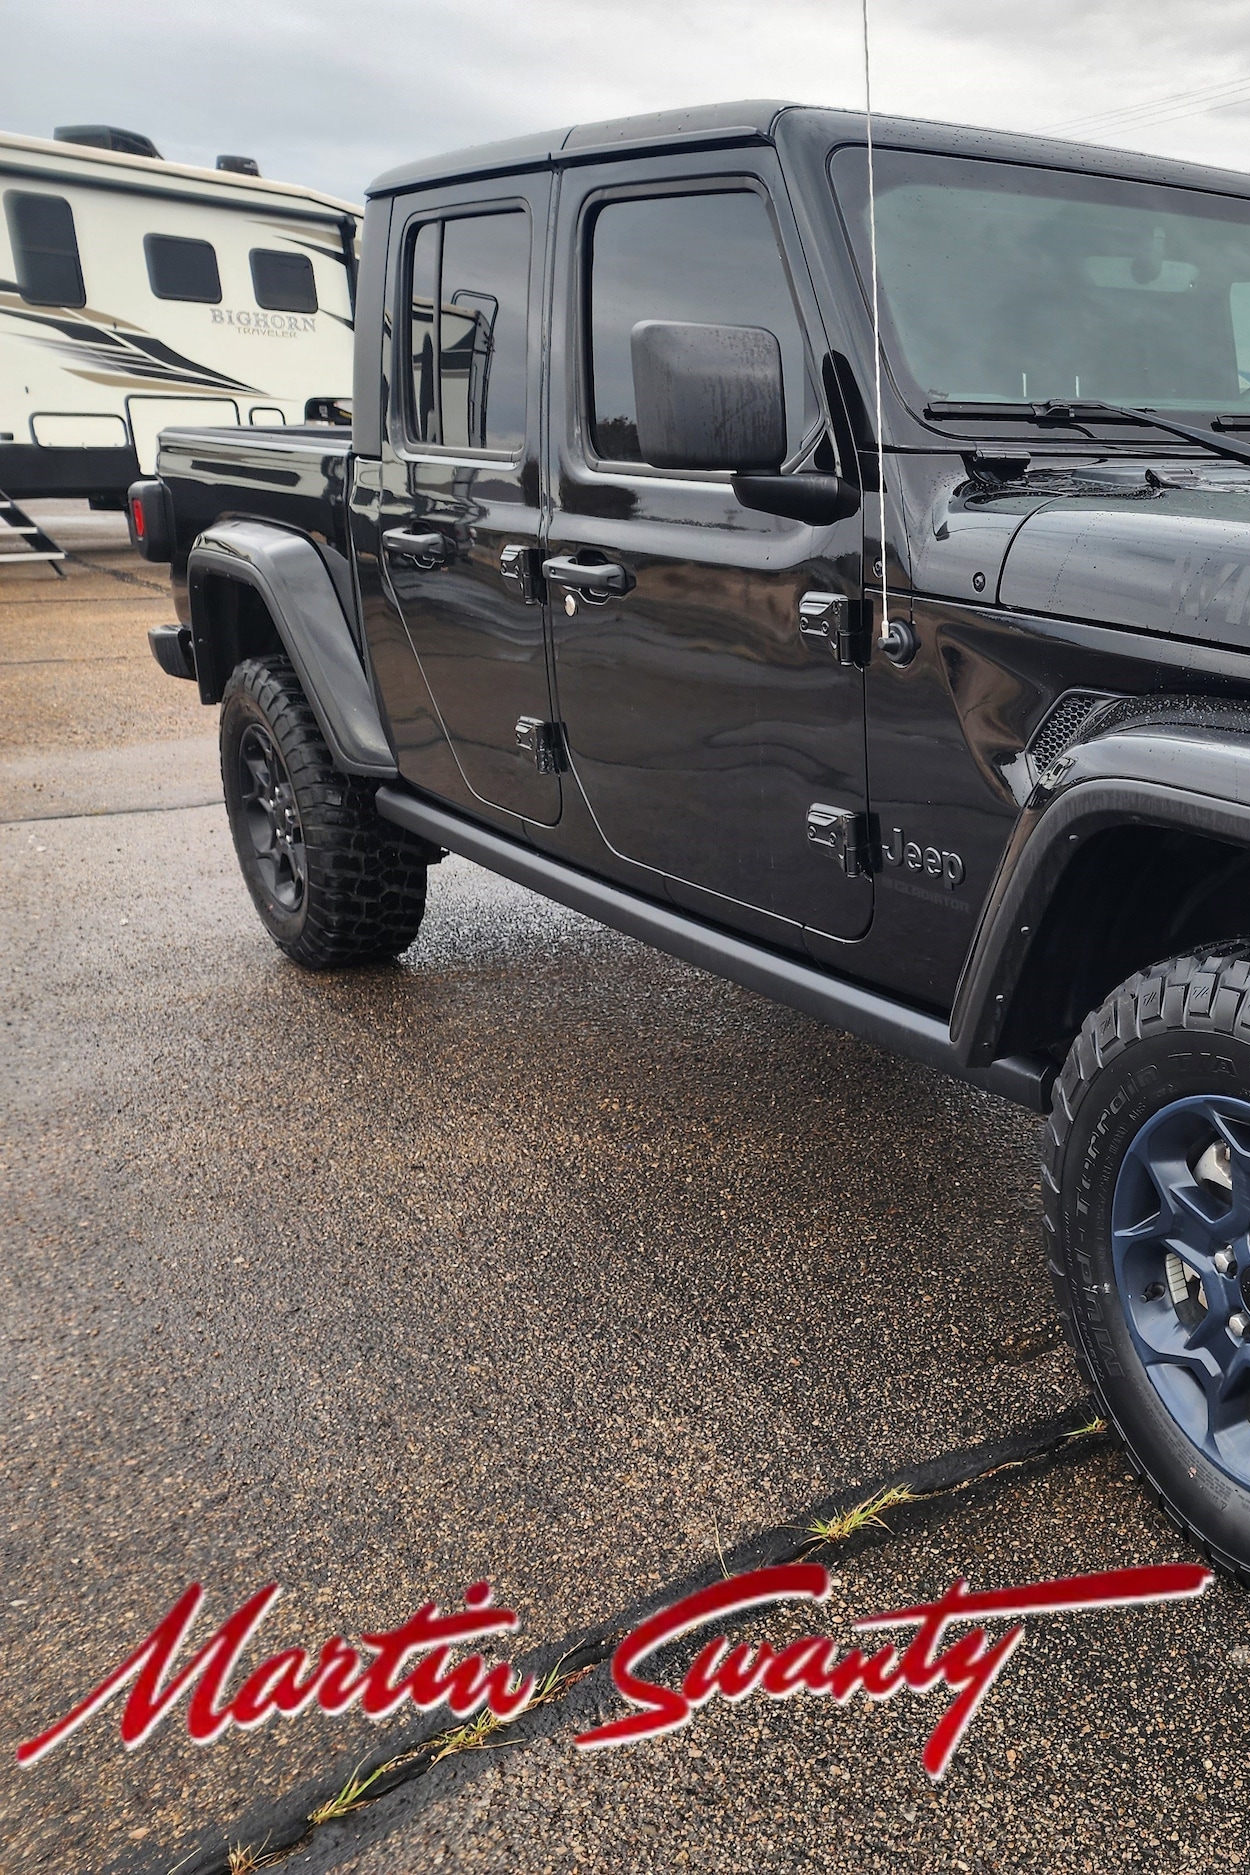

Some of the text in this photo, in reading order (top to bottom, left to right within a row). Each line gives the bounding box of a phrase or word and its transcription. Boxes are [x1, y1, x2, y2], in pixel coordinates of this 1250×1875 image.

[210, 308, 316, 332] BIGHORN
[236, 326, 298, 338] TRAVELER
[881, 827, 965, 891] Jeep
